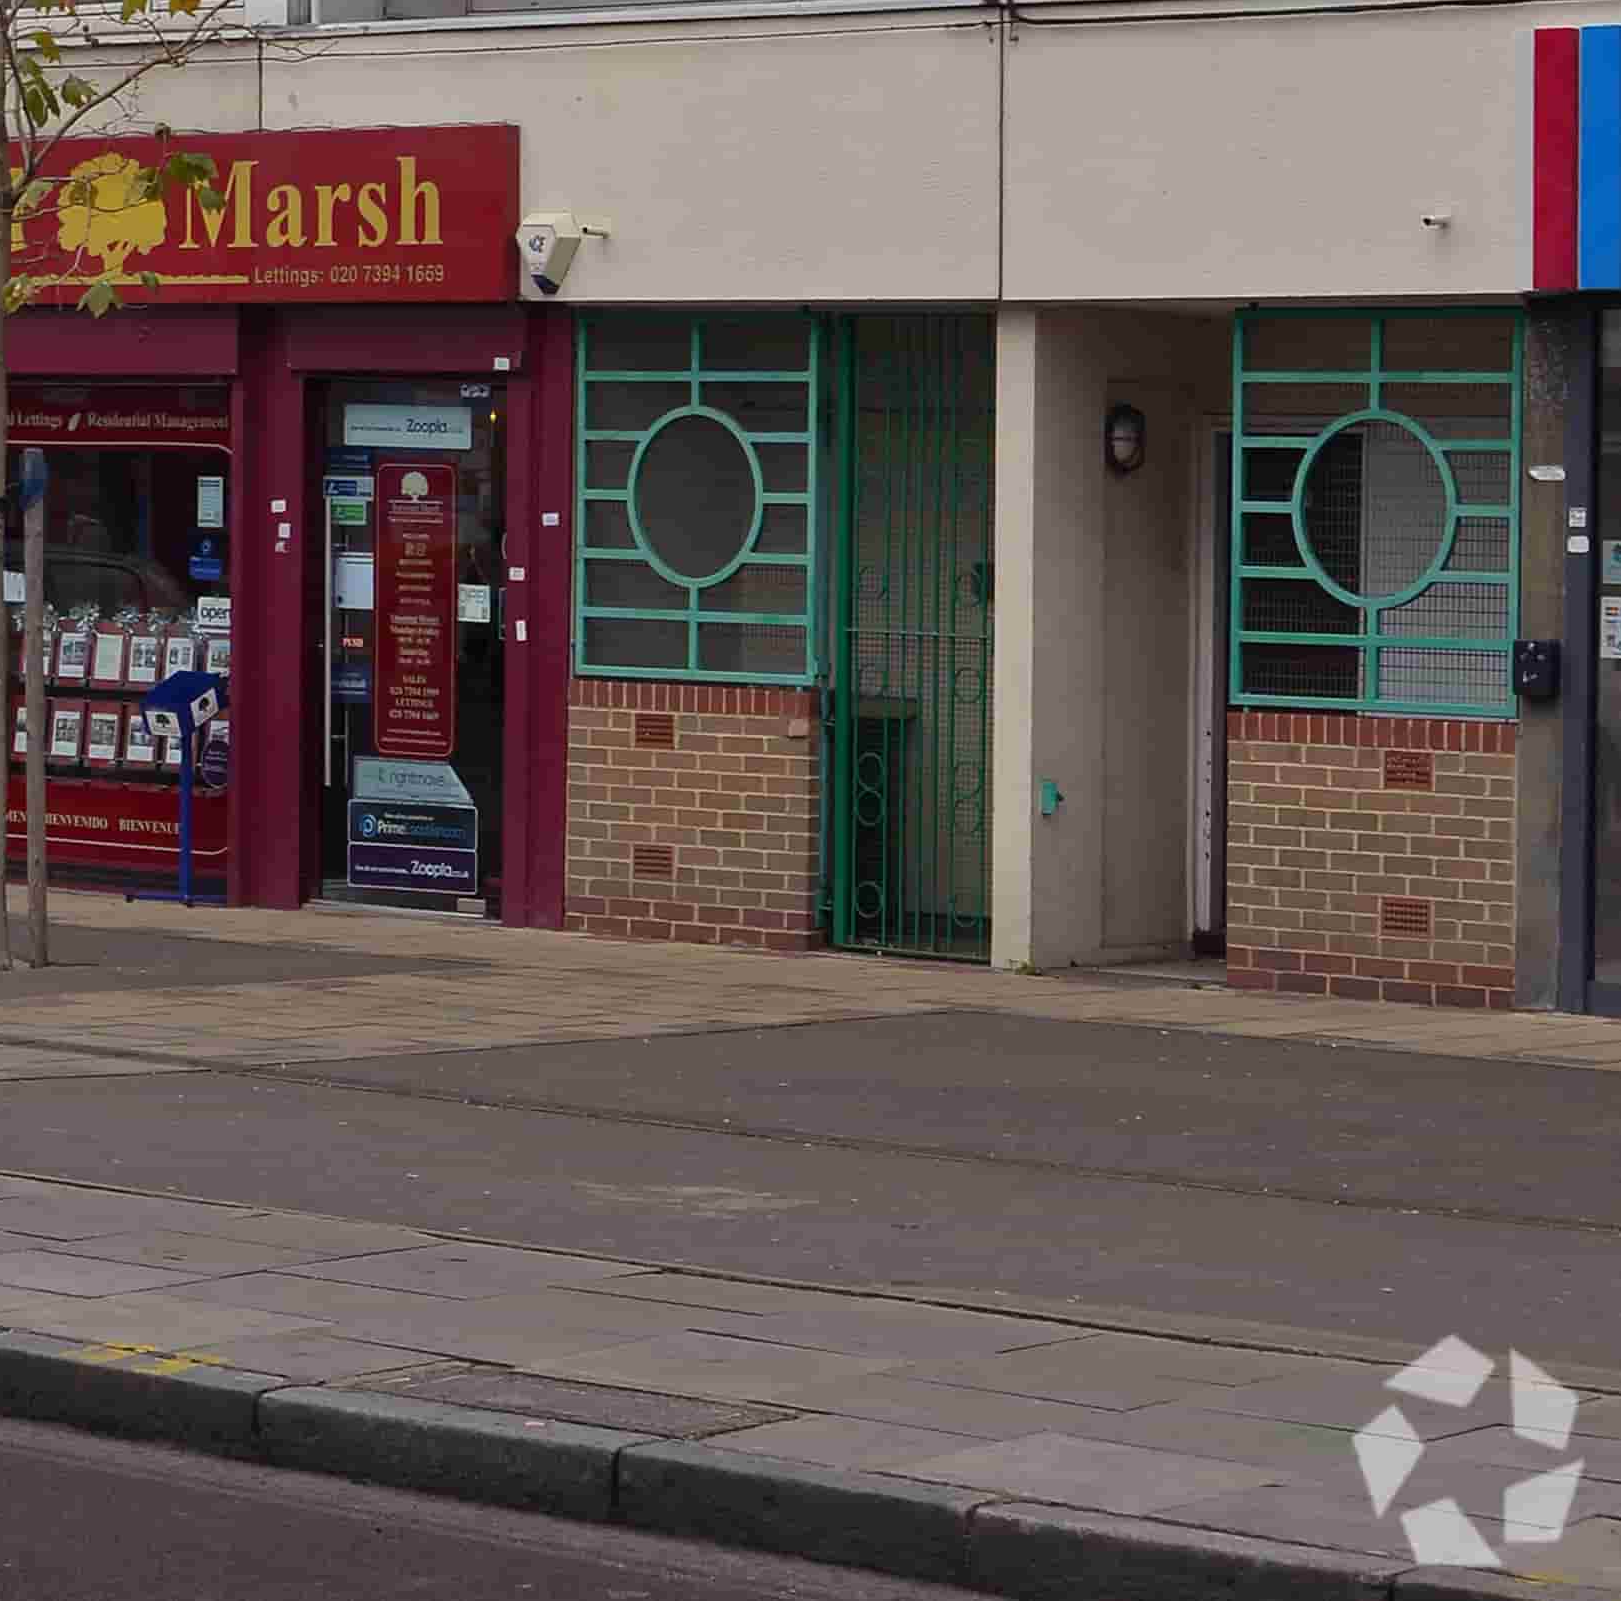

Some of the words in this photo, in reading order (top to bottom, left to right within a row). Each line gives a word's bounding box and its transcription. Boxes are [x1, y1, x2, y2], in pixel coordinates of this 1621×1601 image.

[178, 156, 444, 249] Marsh
[254, 266, 324, 286] Lettings:
[329, 266, 356, 284] 020
[362, 265, 400, 283] 7394
[87, 413, 151, 429] Residential
[154, 414, 229, 431] Management
